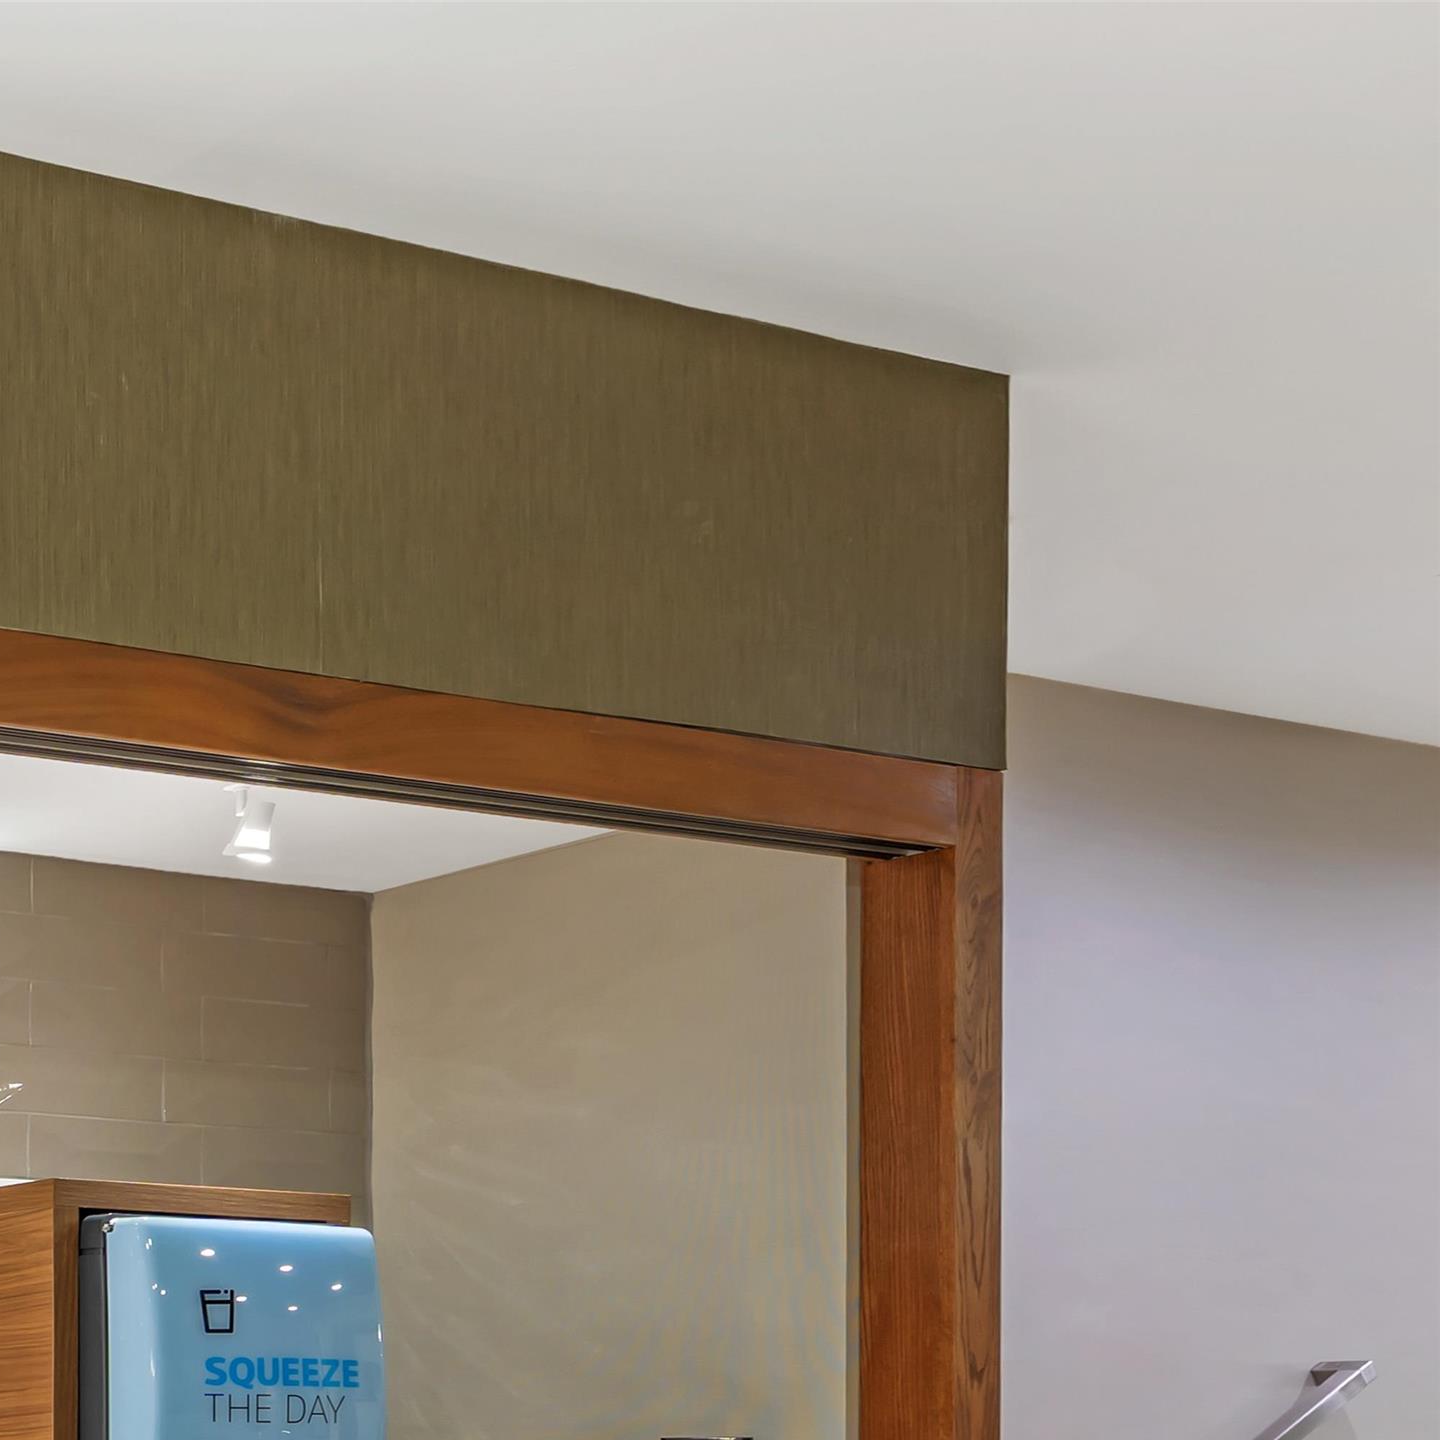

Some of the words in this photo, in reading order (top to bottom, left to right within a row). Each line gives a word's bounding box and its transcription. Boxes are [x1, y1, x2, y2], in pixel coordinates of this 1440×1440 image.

[204, 1356, 360, 1389] SQUEEZE
[204, 1393, 271, 1423] THE
[286, 1393, 346, 1424] DAY
